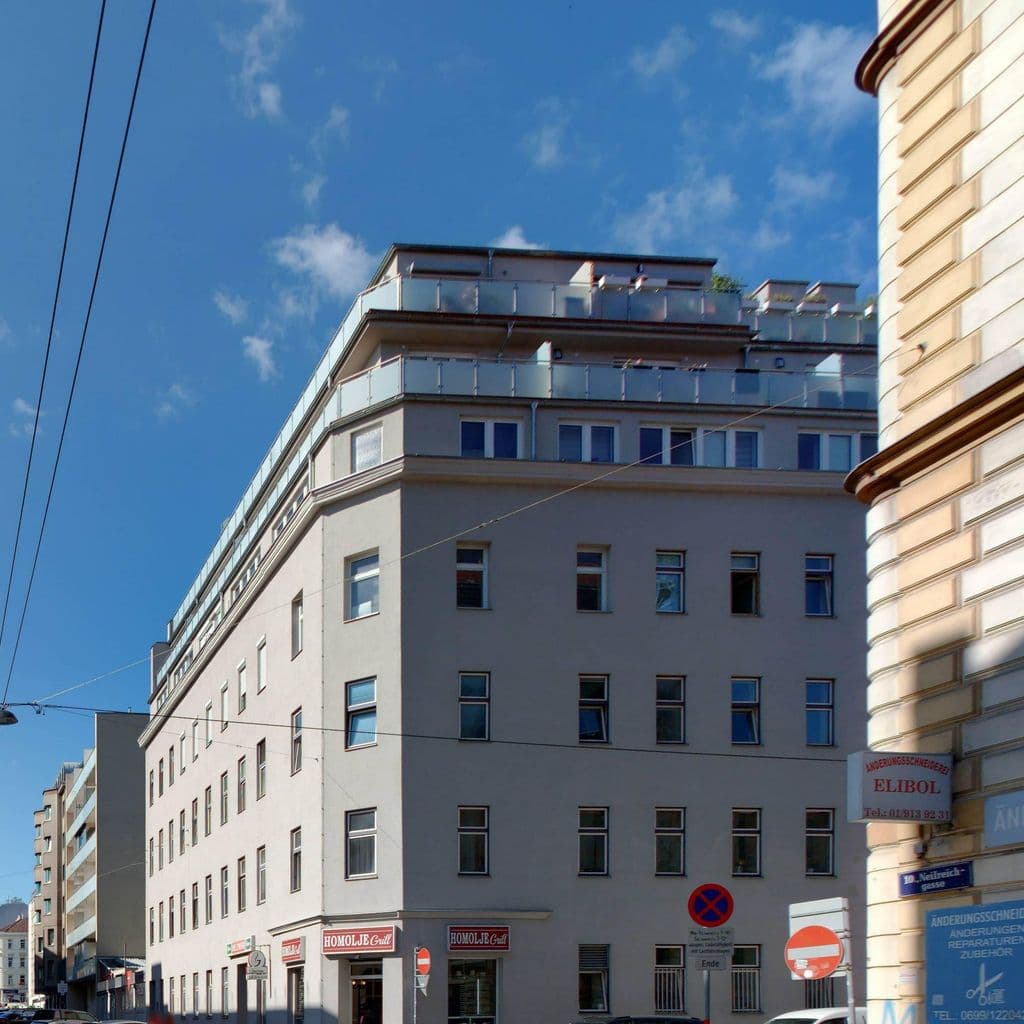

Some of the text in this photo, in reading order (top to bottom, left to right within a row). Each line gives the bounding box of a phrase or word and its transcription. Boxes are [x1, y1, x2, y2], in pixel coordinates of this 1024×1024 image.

[874, 779, 941, 794] ELIBOL
[994, 804, 1024, 832] ÄN
[324, 933, 393, 947] HOMOLJE Grill
[450, 932, 489, 945] HOMOLJE
